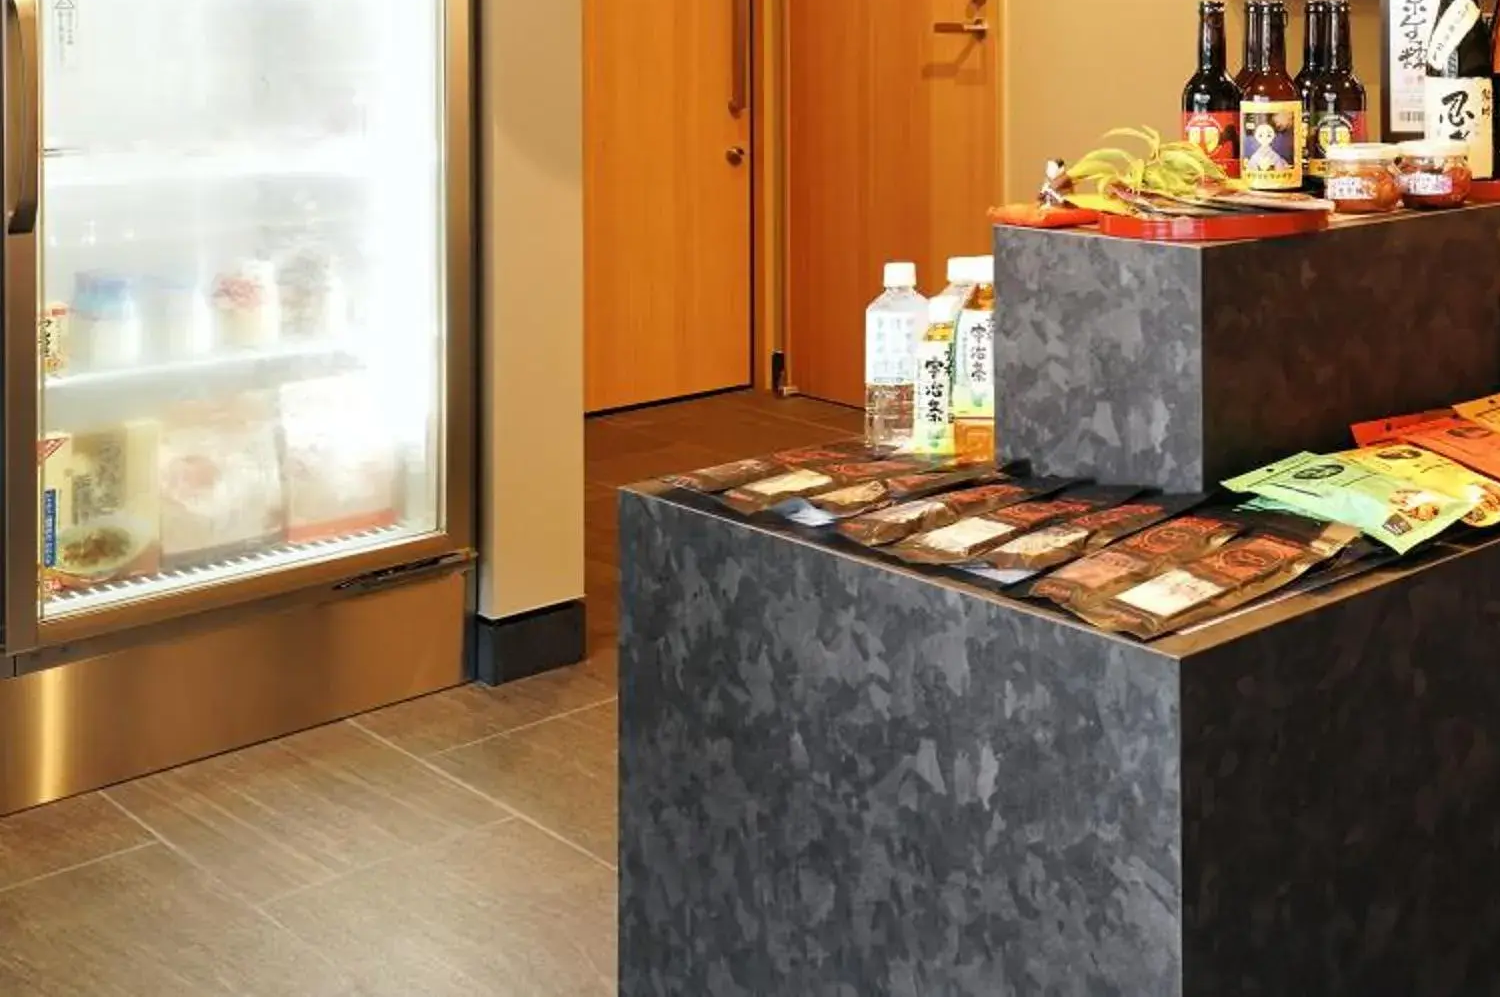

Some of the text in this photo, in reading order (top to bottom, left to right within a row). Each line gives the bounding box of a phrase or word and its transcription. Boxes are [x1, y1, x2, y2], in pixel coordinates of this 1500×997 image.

[970, 323, 987, 383] 宇治茶
[924, 356, 944, 424] 宇治茶
